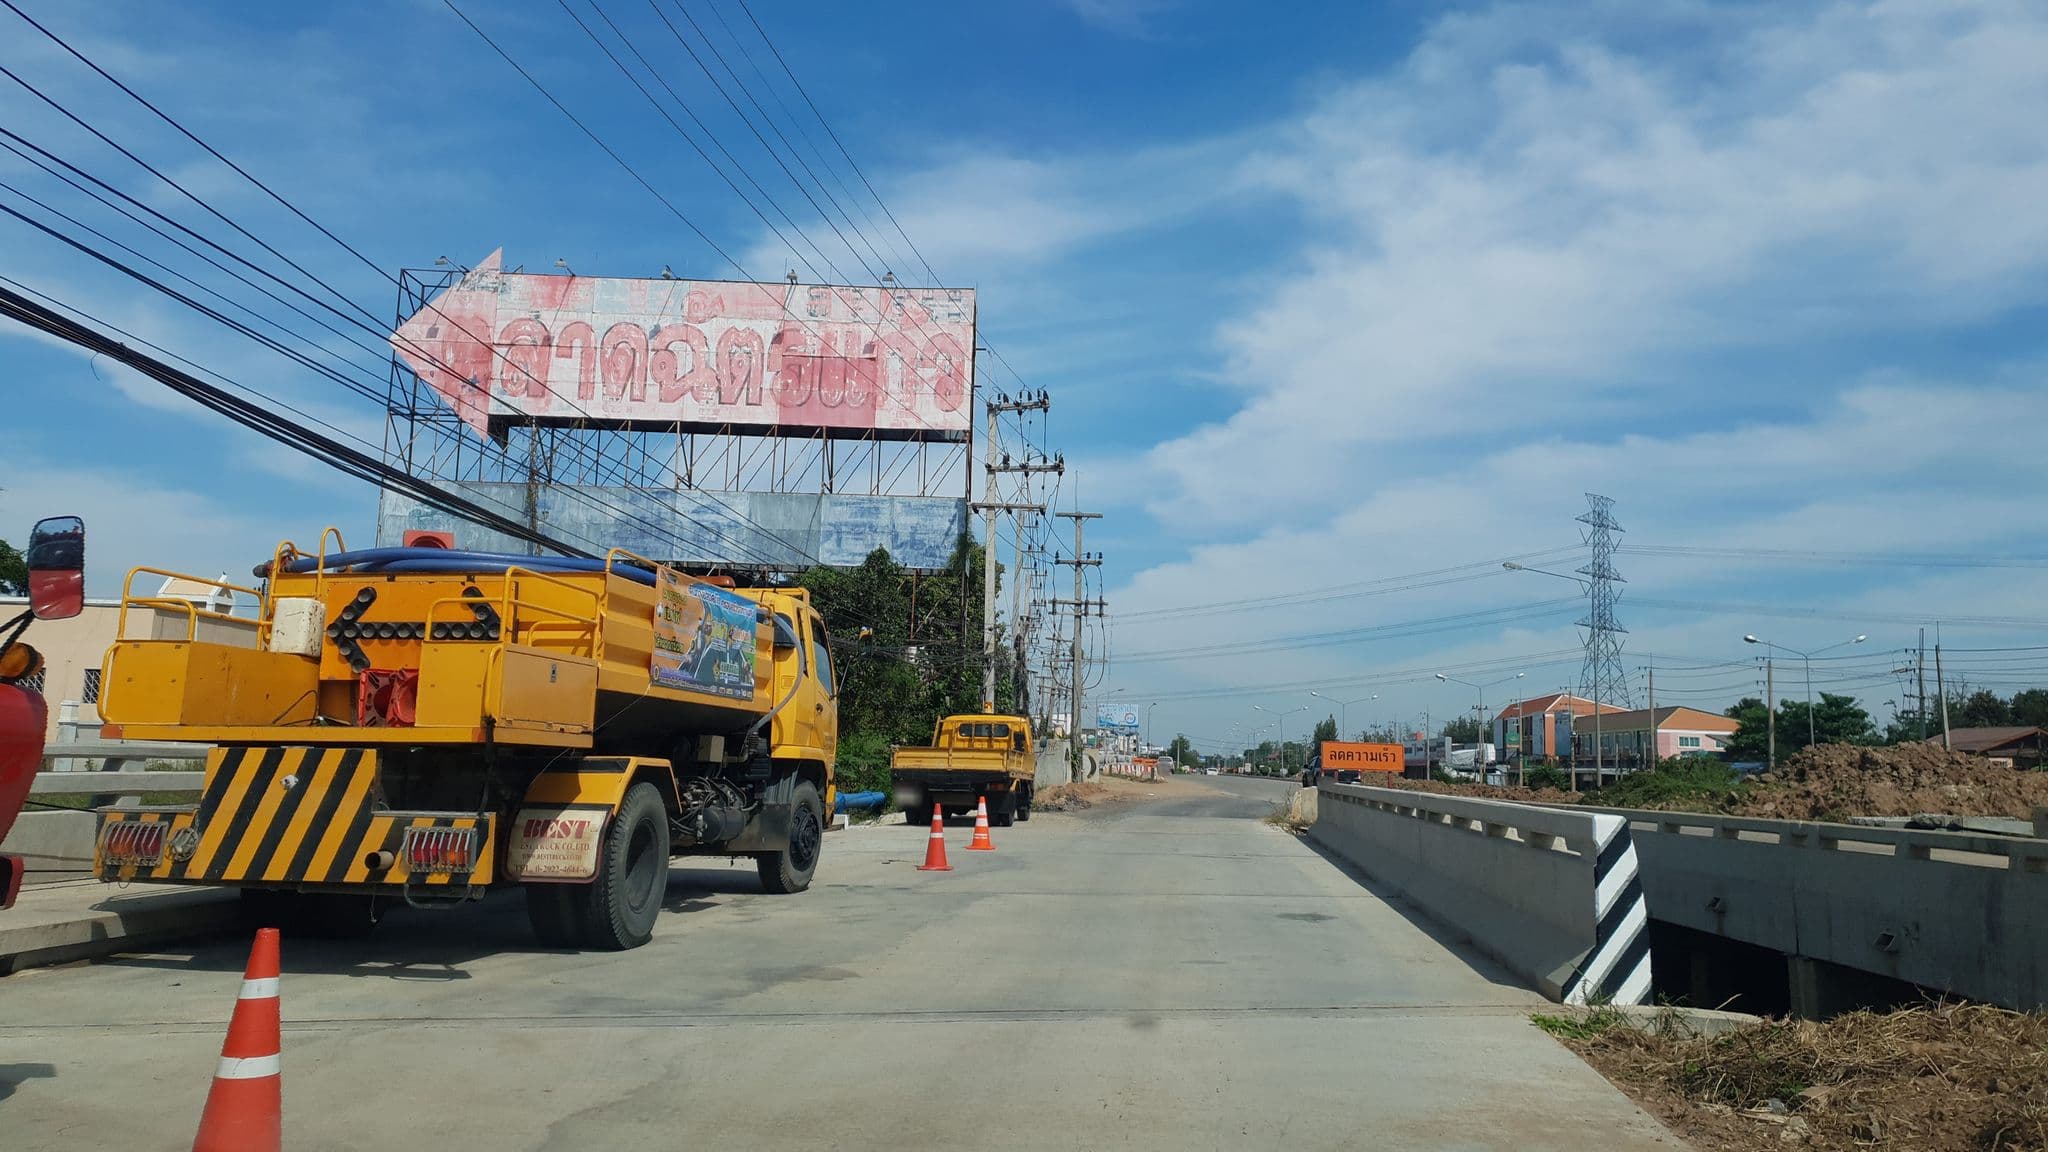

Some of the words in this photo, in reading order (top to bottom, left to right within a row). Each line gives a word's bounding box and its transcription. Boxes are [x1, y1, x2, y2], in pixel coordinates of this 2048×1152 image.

[1329, 747, 1396, 763] ลดความเร็ว
[523, 819, 591, 839] BEST
